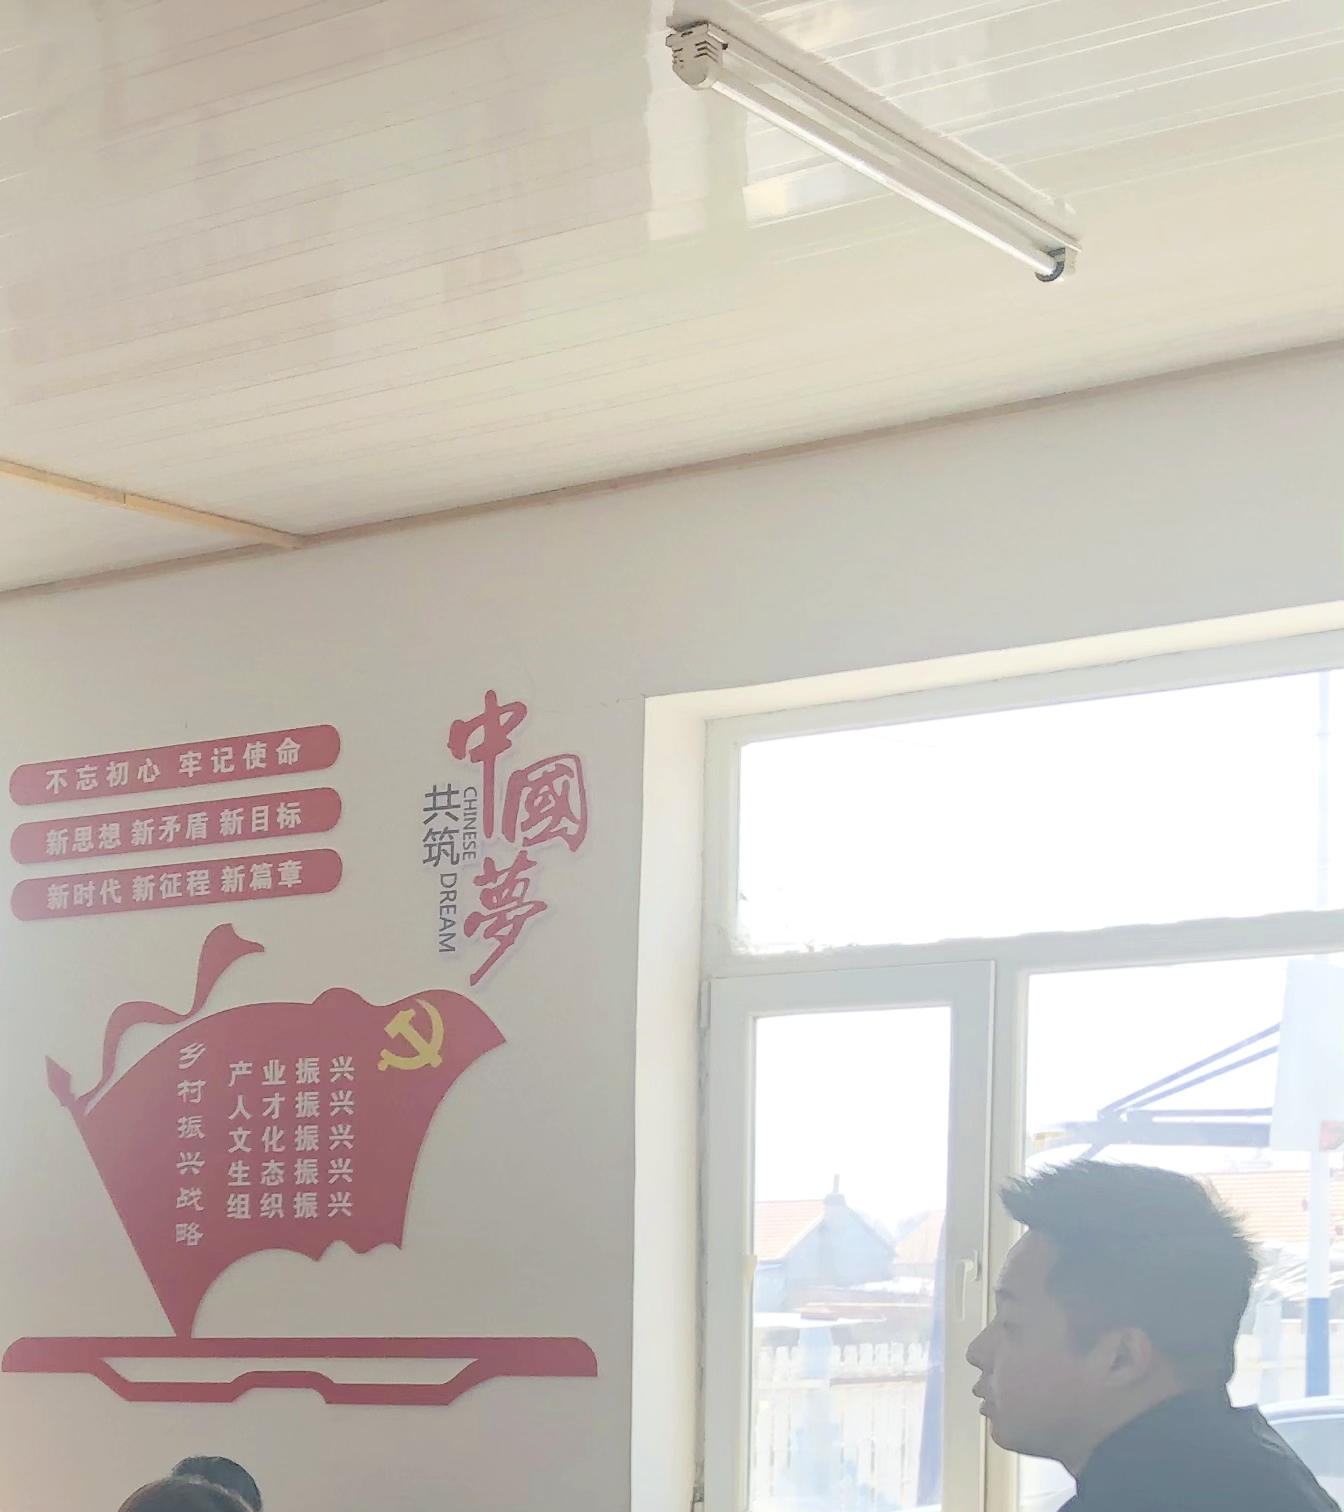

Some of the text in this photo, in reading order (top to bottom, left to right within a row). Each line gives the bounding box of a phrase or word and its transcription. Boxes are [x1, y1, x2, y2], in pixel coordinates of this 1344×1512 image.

[45, 737, 301, 795] 不忘初心 牢记使命
[46, 802, 302, 856] 新思想 新矛盾 新目标
[422, 783, 461, 867] 共筑
[462, 786, 477, 860] CHINESE
[47, 860, 303, 910] 新时代 新征程 新篇章
[439, 873, 457, 952] DREAM
[228, 1056, 355, 1087] 产业振兴
[228, 1090, 355, 1120] 人才振兴
[176, 1042, 206, 1246] 乡村振兴战略
[228, 1124, 355, 1153] 文化振兴
[227, 1158, 353, 1186] 生态振兴
[226, 1191, 353, 1219] 组织振兴
